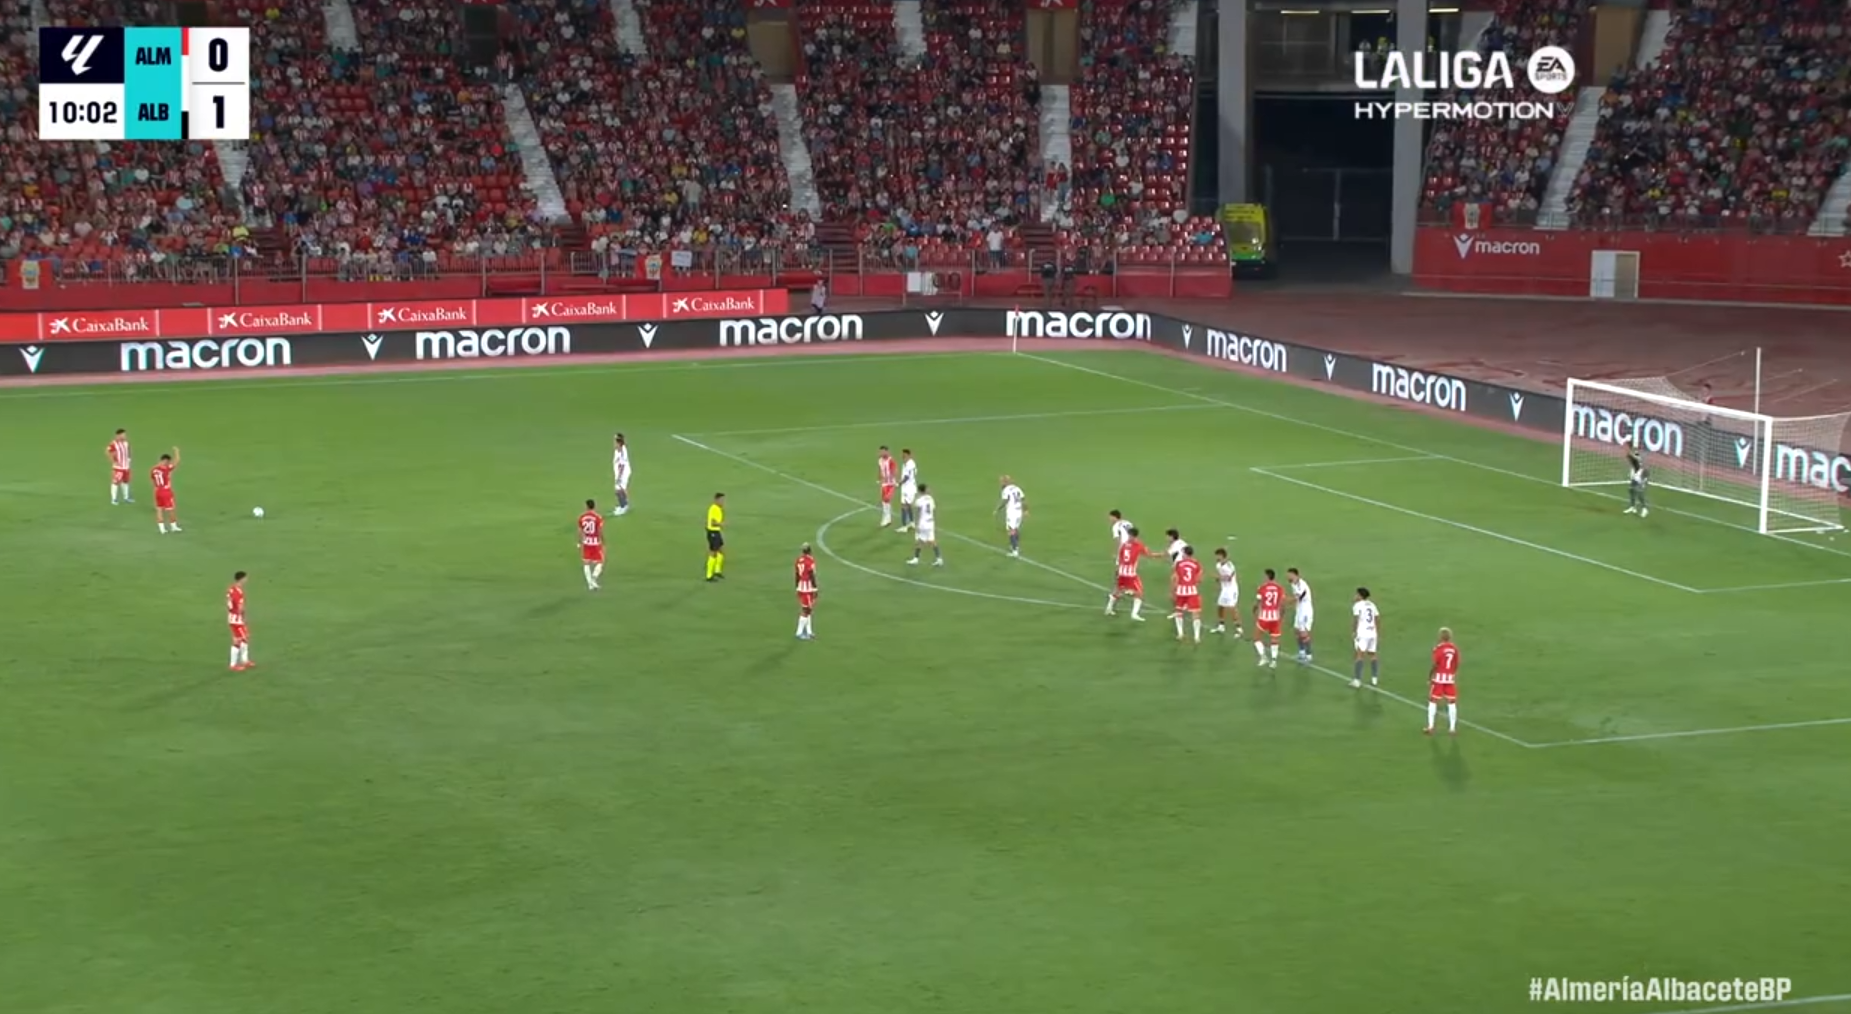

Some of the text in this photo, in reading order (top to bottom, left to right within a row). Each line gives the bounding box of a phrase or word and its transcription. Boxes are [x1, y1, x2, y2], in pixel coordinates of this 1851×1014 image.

[1475, 241, 1540, 255] macron
[551, 302, 617, 318] CaixaBank
[689, 296, 755, 314] CaixaBank
[239, 312, 313, 329] CaixaBank
[399, 307, 467, 323] CaixaBank
[72, 316, 150, 334] CaixaBank
[719, 314, 863, 347] macron
[1006, 310, 1151, 339] macron
[415, 326, 571, 361] macron
[1207, 328, 1287, 372] macron
[120, 336, 292, 372] macron
[1372, 363, 1466, 411] macron
[1571, 404, 1683, 457] macron
[582, 520, 595, 534] 20
[1183, 567, 1192, 582] 3
[1365, 608, 1373, 623] 3
[1445, 653, 1454, 669] 7
